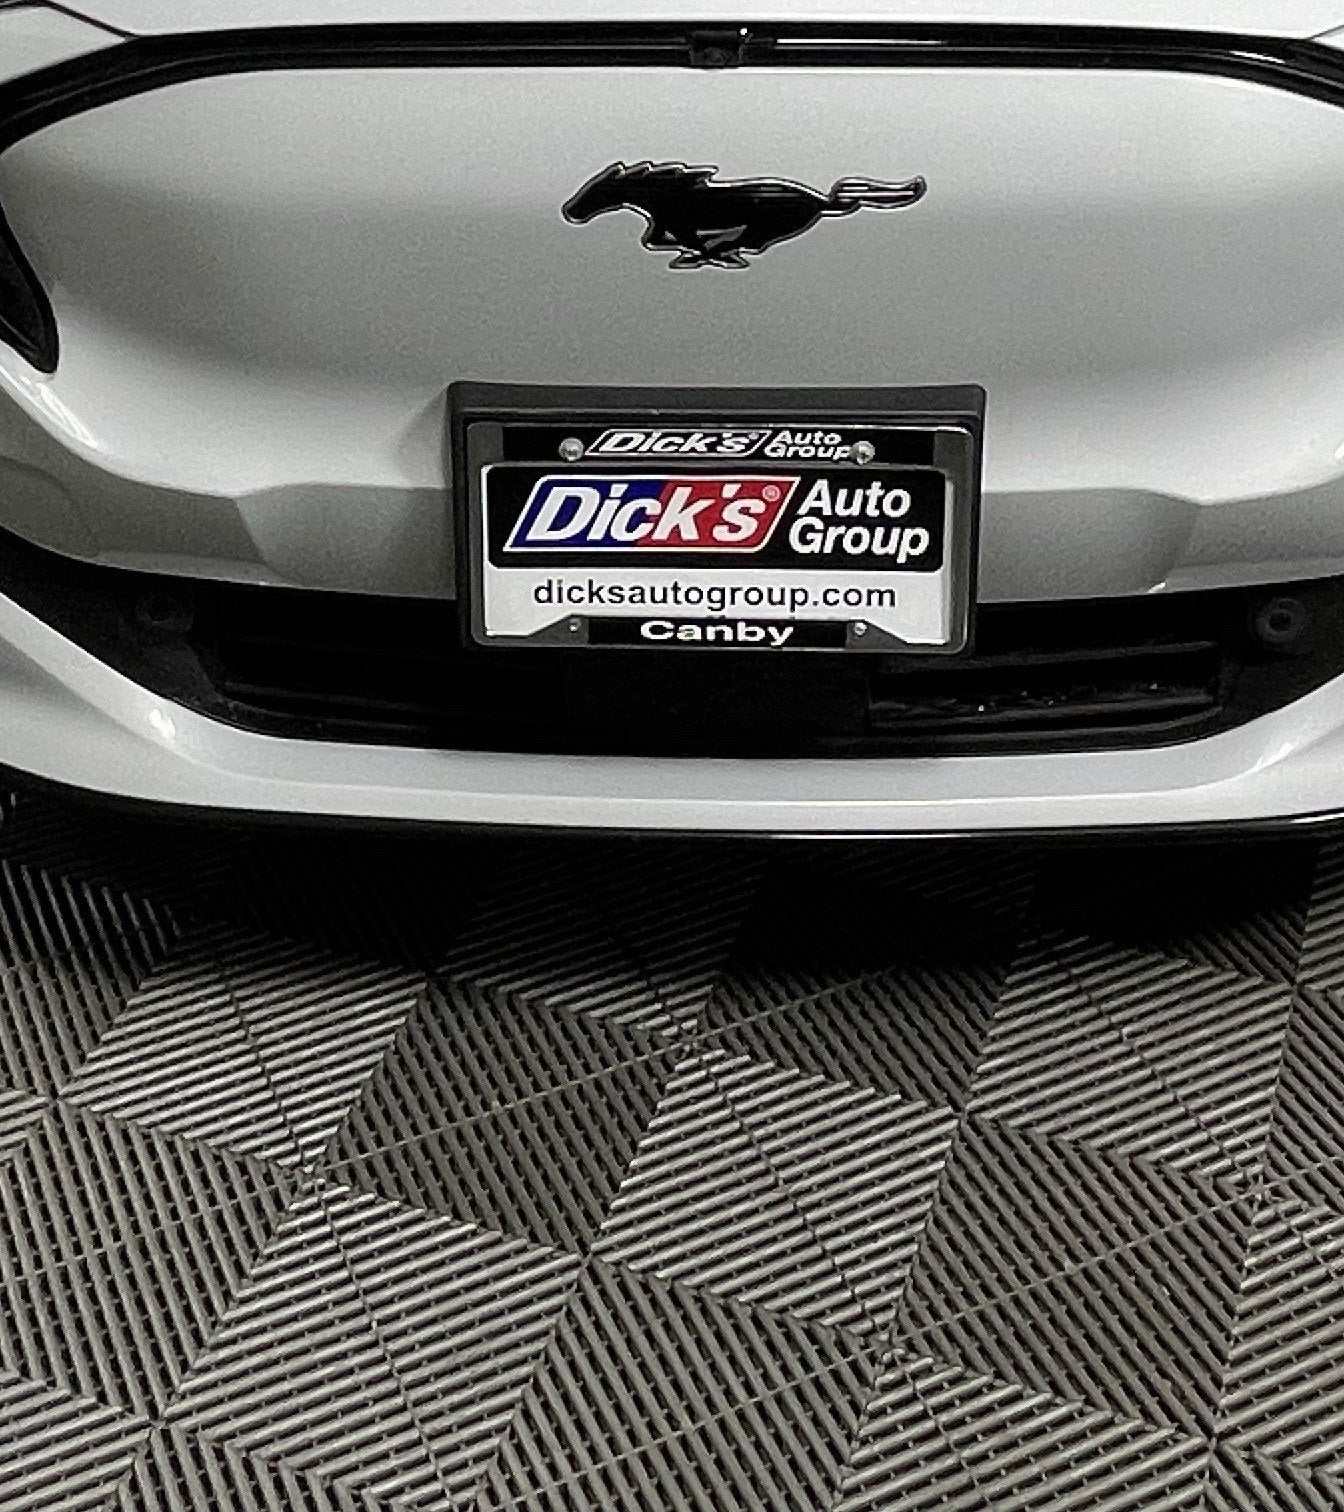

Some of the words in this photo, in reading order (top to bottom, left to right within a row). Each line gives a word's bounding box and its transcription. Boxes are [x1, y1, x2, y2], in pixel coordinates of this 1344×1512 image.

[599, 429, 751, 452] Dick's
[763, 443, 853, 461] Group
[771, 430, 842, 445] Auto
[525, 483, 766, 541] Dick's
[796, 478, 912, 518] Auto
[788, 516, 930, 563] Group
[533, 579, 897, 611] dicksautogroup.com
[639, 619, 795, 645] Canby
